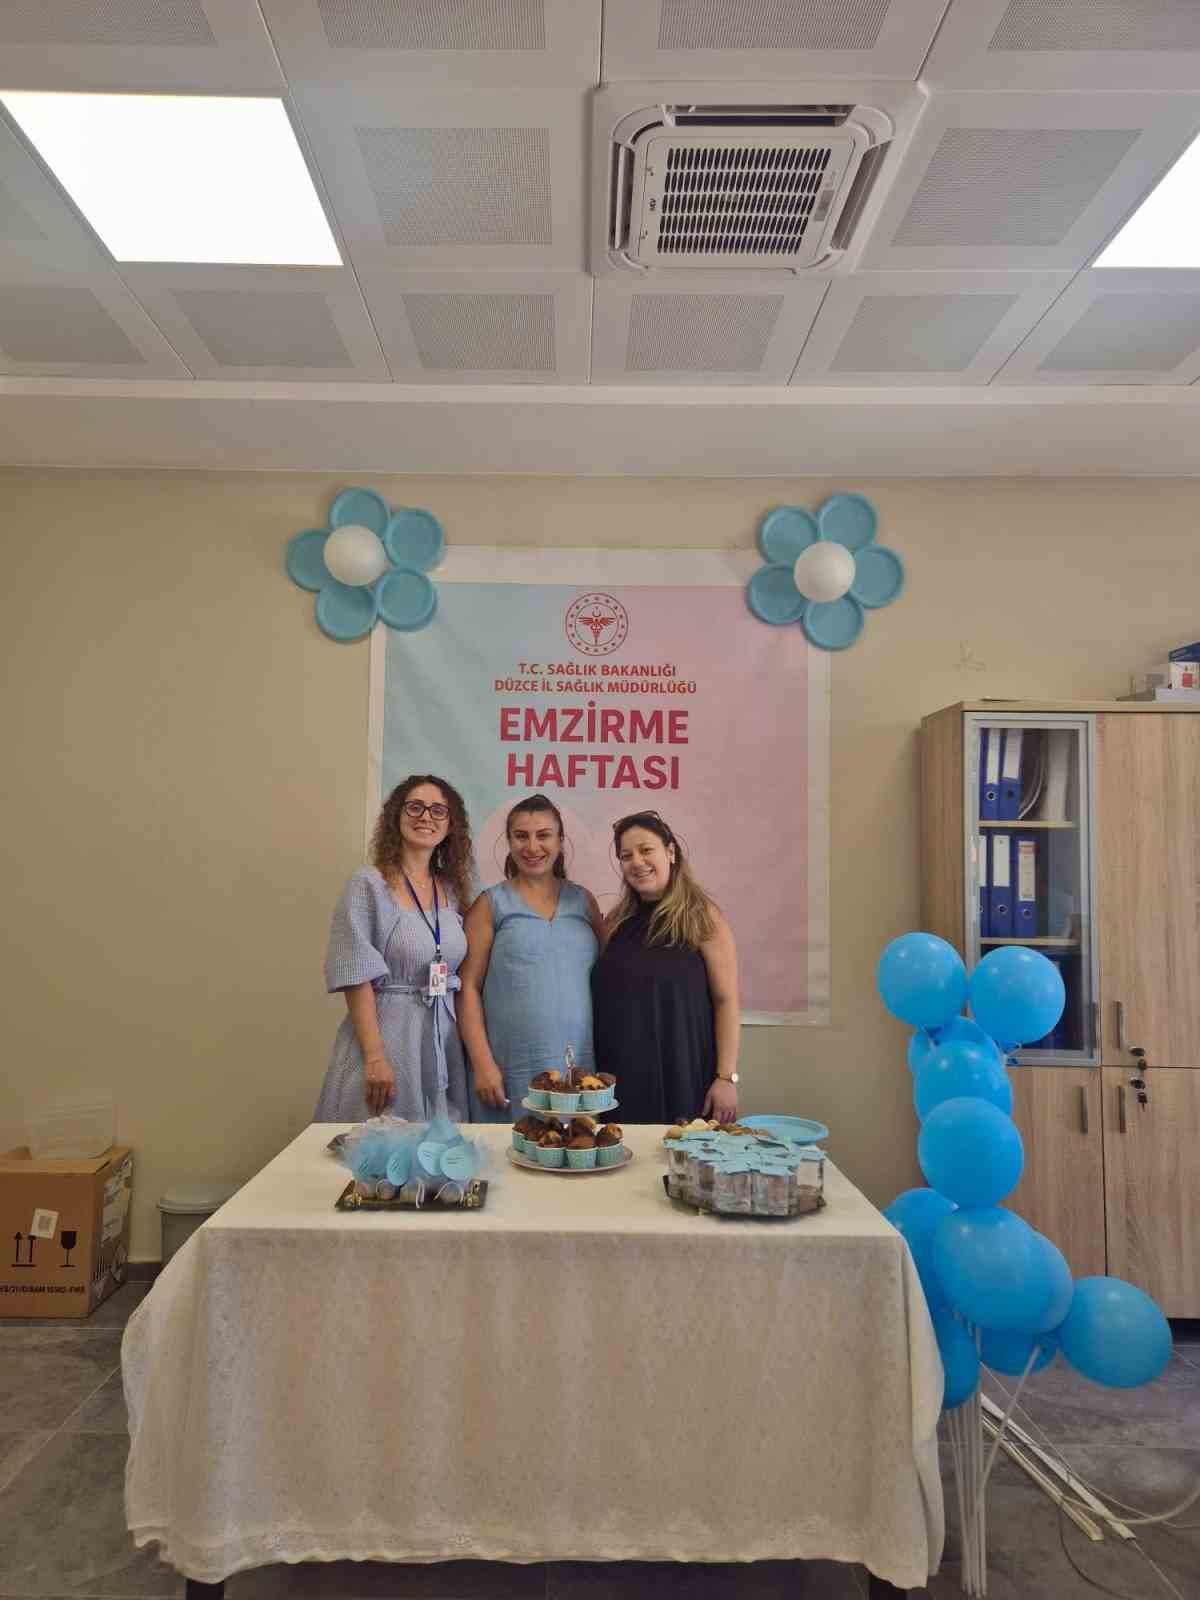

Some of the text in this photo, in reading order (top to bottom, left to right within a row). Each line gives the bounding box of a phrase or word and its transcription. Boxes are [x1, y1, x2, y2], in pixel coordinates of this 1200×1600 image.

[519, 661, 676, 677] T.C. SAĞLIK BAKANLIĞI
[495, 678, 697, 693] DÜZCE İL SAĞLIK MÜDÜRLÜĞÜ
[500, 700, 689, 744] EMZİRME
[507, 753, 680, 790] HAFTASI
